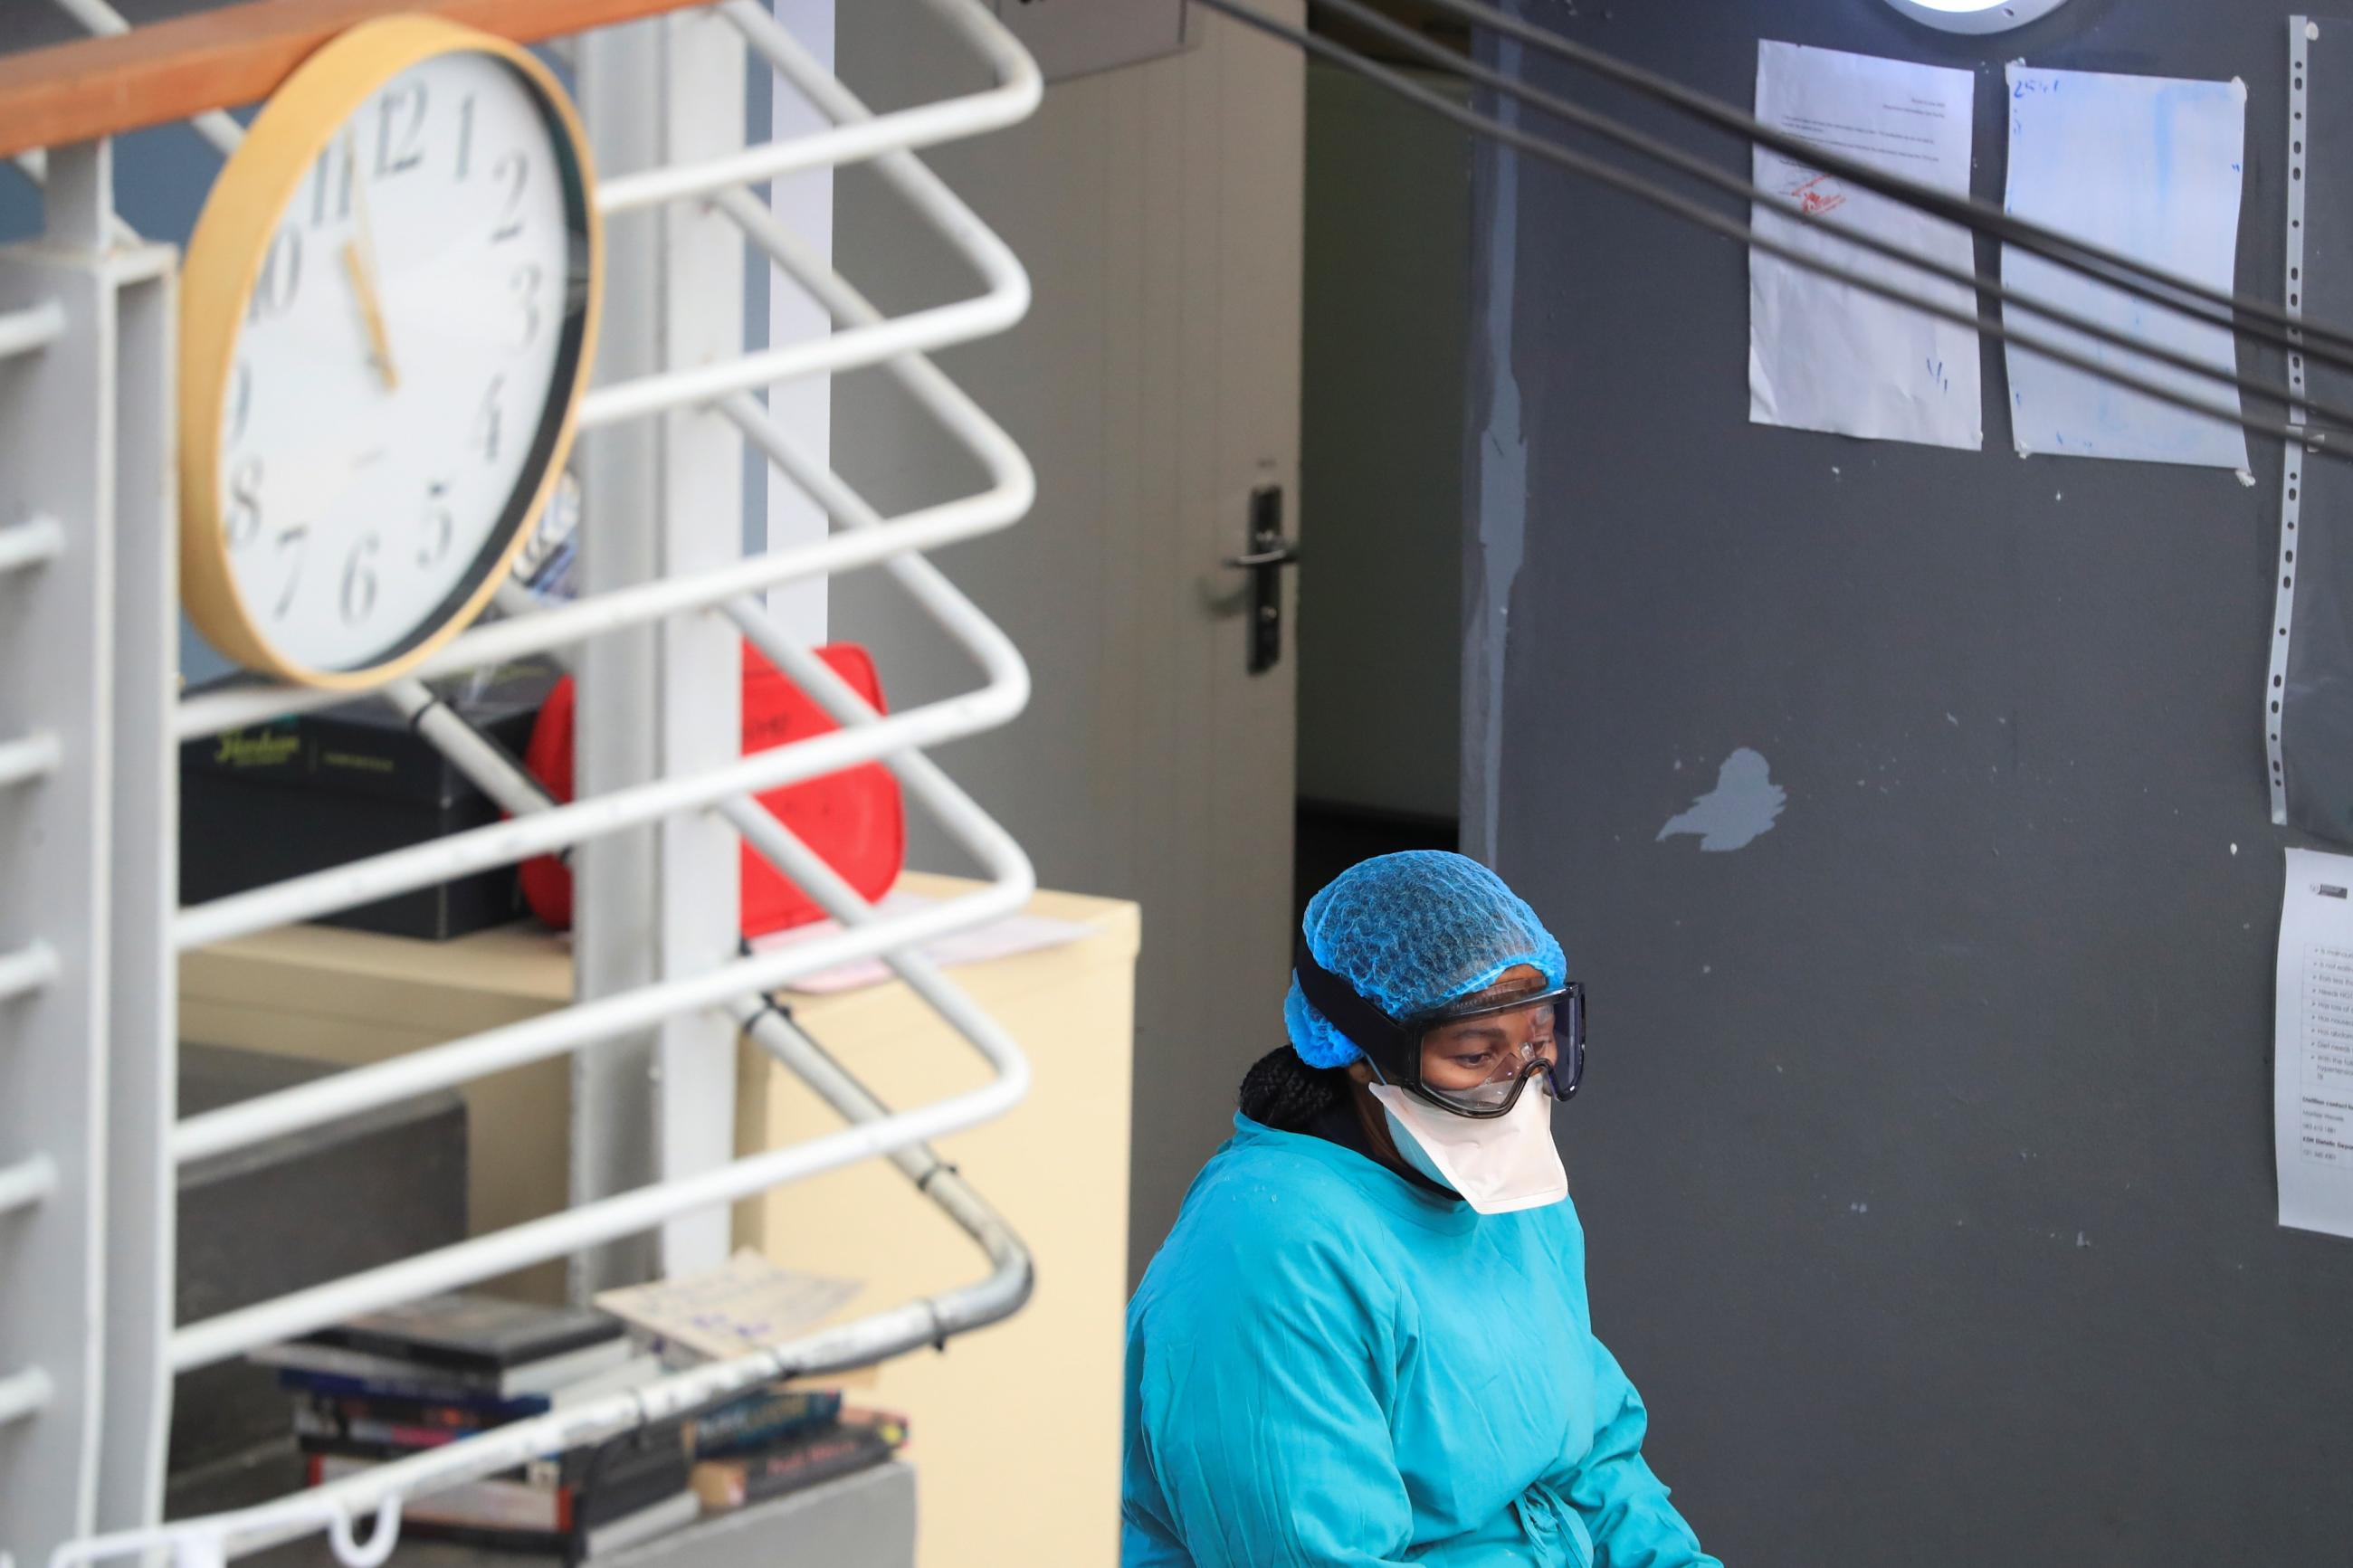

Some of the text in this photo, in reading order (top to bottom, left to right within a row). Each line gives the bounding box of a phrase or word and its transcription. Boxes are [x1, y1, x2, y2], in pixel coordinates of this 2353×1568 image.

[375, 78, 427, 180] 12
[456, 94, 475, 184] 1
[491, 150, 529, 243] 2
[510, 263, 542, 356] 3
[470, 373, 506, 462] 4
[227, 457, 263, 549] 8
[417, 480, 455, 569] 5
[277, 523, 310, 622] 7
[339, 531, 379, 627] 6
